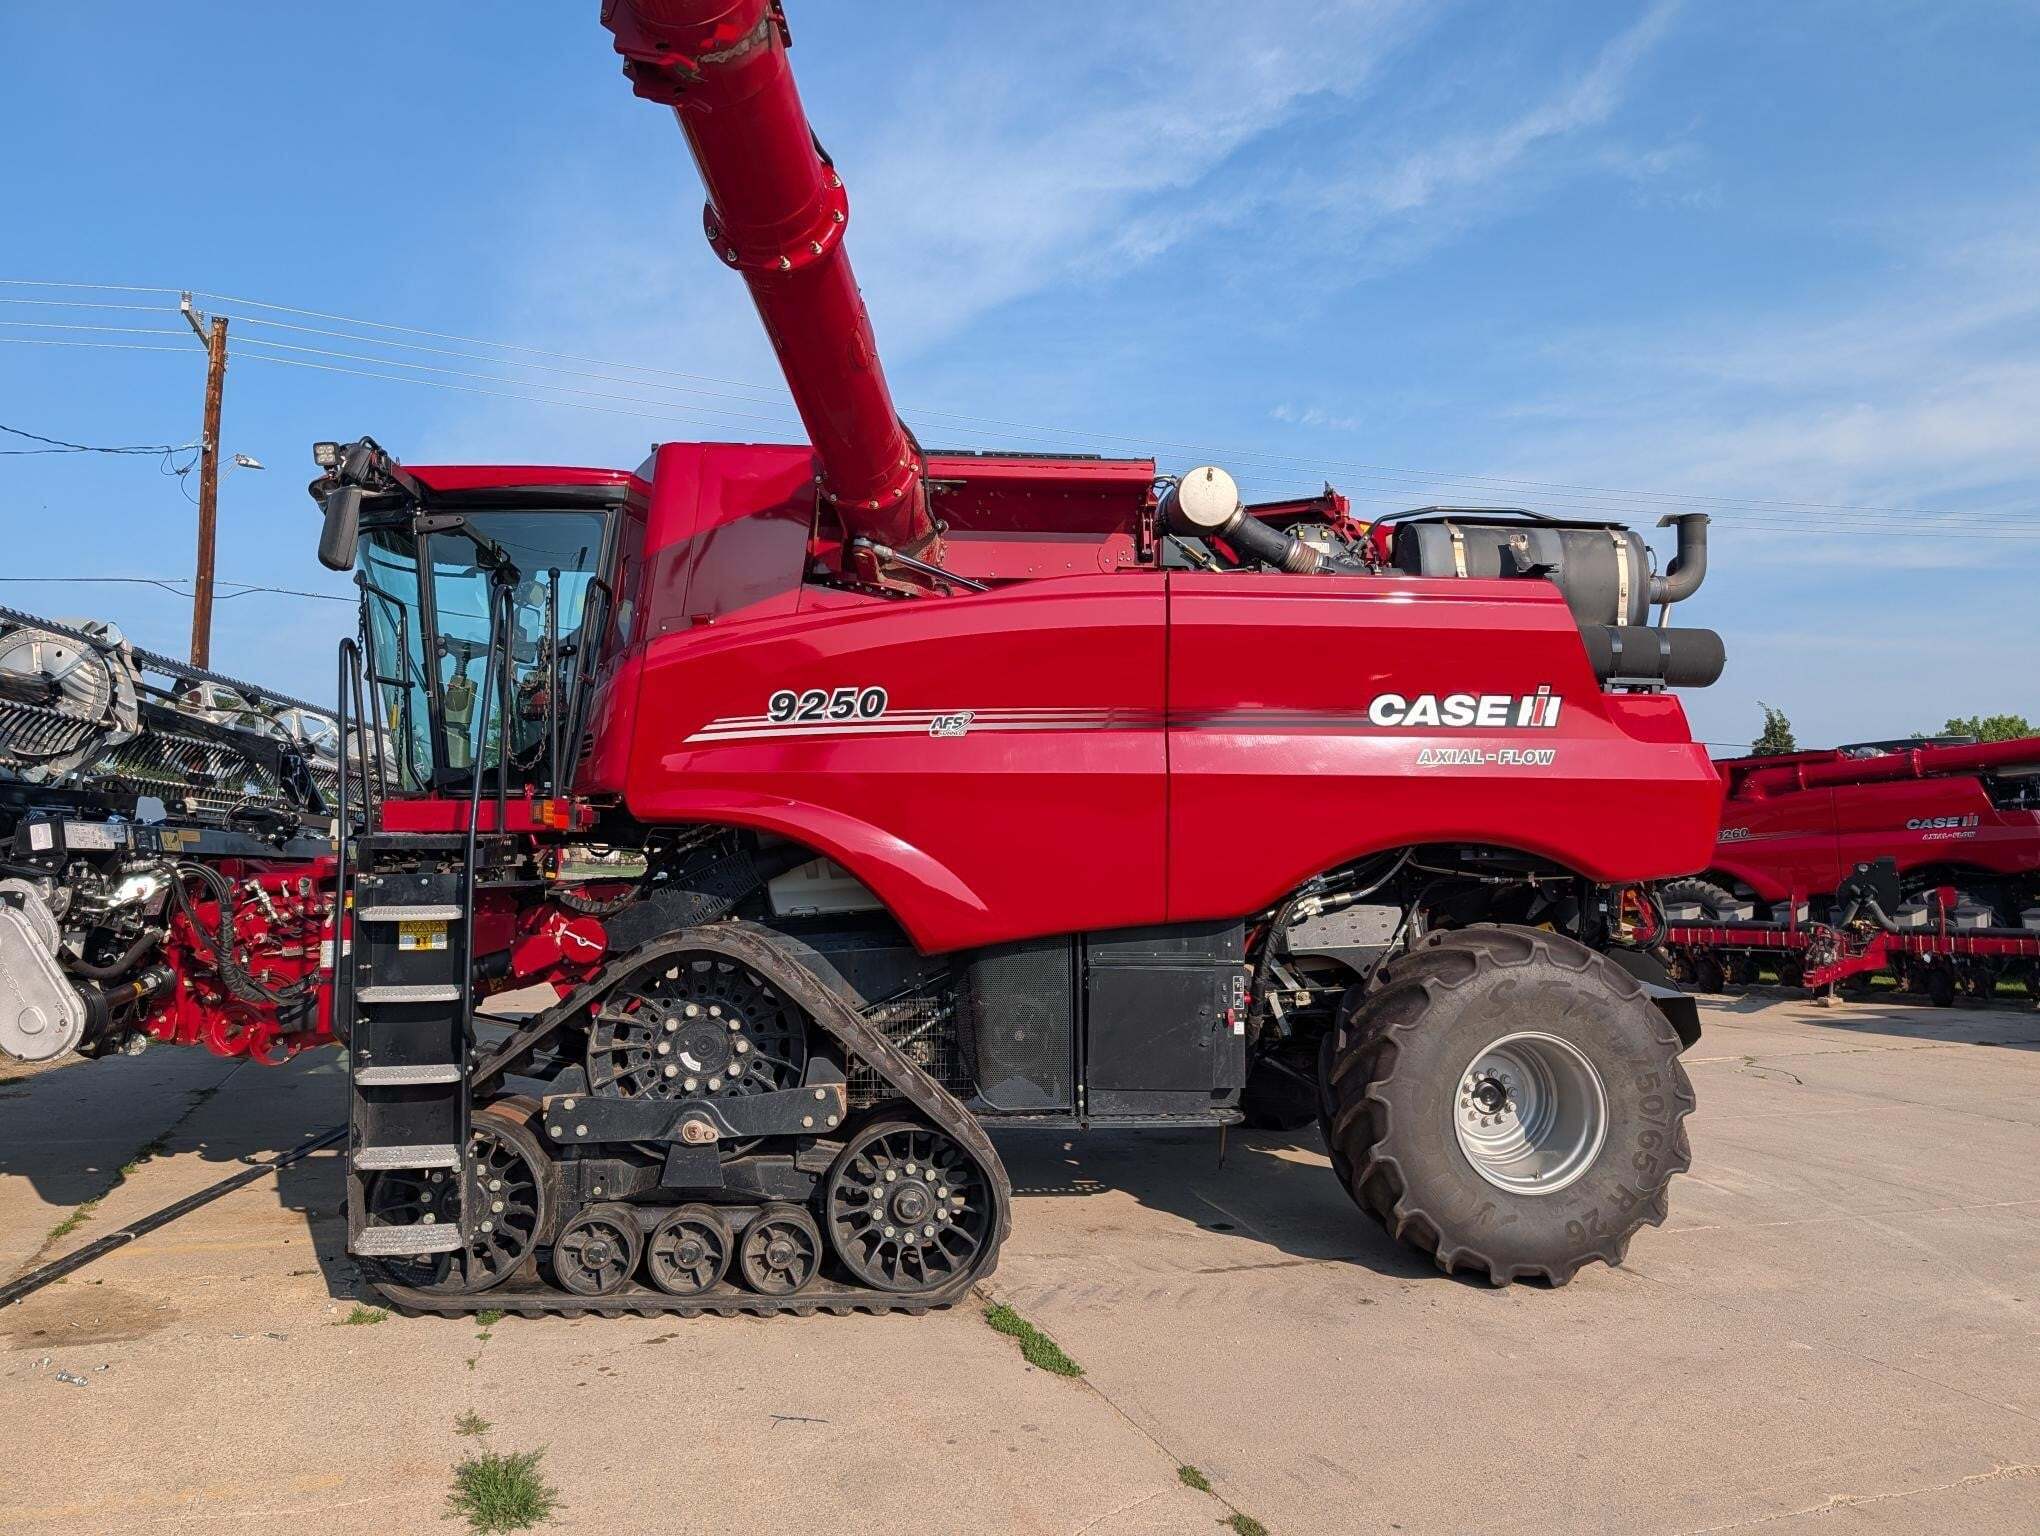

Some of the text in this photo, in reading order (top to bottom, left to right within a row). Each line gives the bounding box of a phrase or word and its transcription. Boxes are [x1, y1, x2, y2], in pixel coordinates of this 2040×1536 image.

[767, 686, 888, 723] 9250
[1368, 693, 1512, 727] CASE
[930, 715, 965, 730] AFS
[1416, 749, 1556, 765] AXIAL-FLOW
[1905, 816, 1960, 830] CASE
